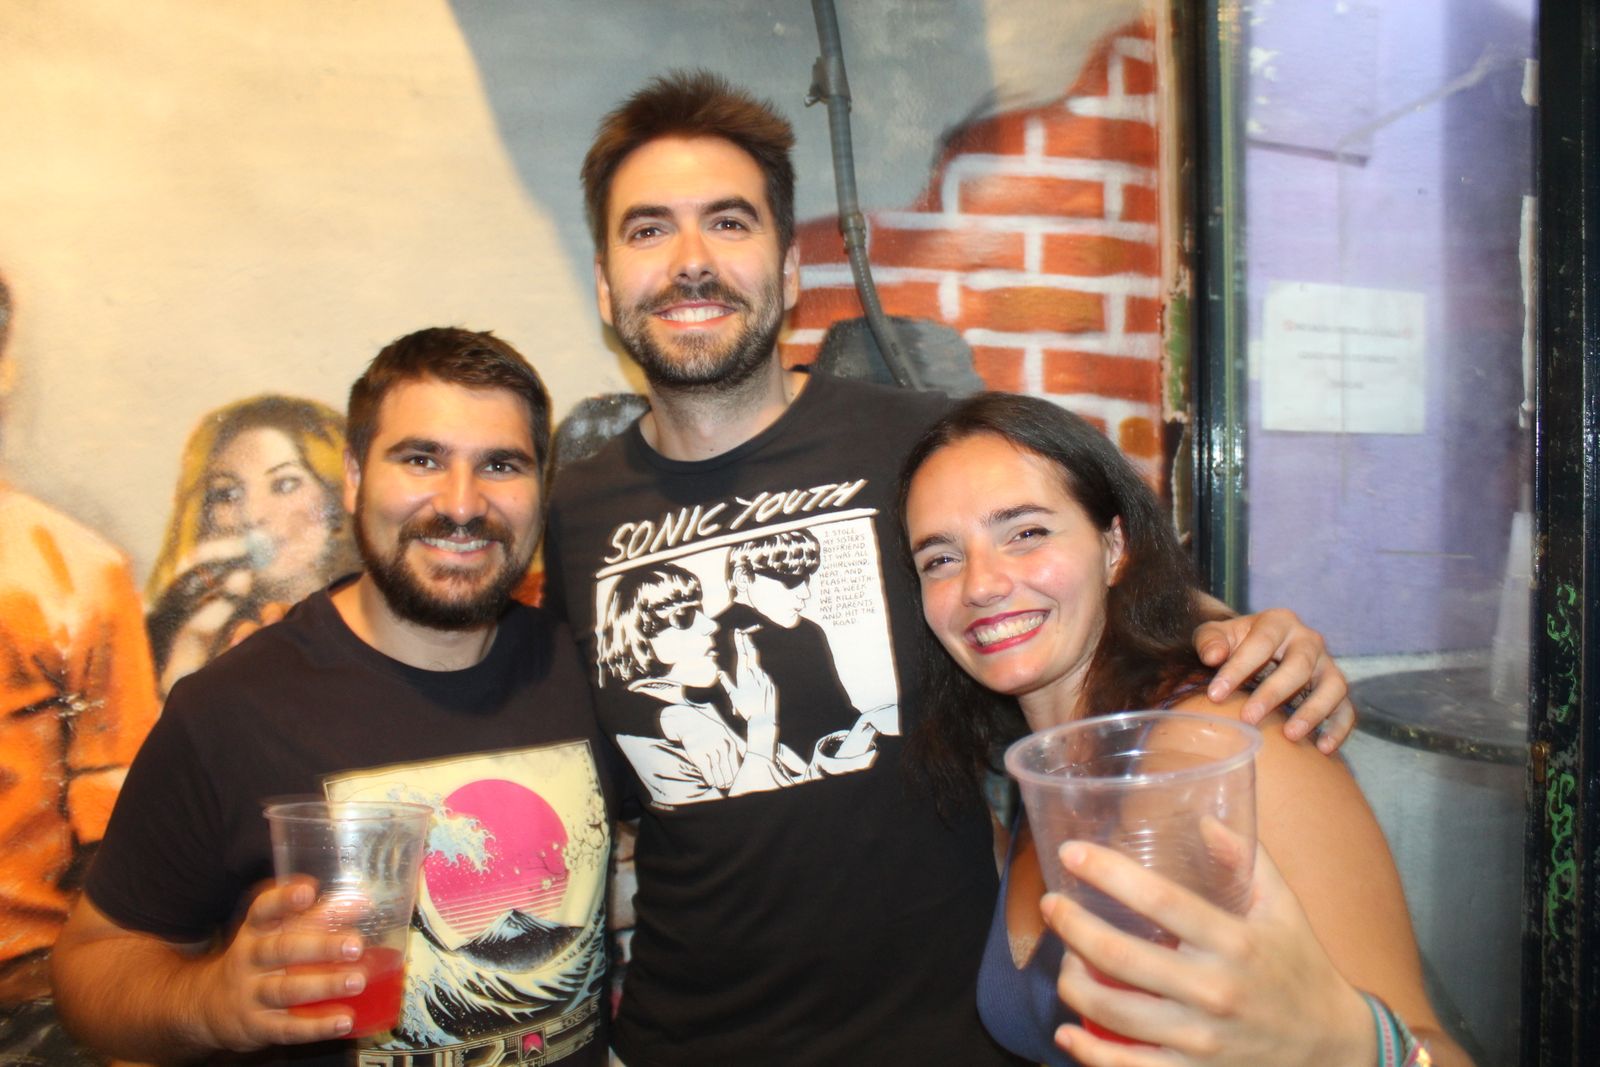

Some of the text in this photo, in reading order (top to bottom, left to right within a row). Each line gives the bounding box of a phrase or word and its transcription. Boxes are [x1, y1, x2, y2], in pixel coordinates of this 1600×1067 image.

[604, 478, 868, 564] SONIC YOUTH
[831, 528, 856, 537] STOLE
[822, 538, 834, 546] MY
[822, 542, 866, 555] BOYFRIEND
[822, 549, 868, 563] IT WAS ALL
[844, 567, 863, 576] AND
[820, 587, 830, 597] IN
[843, 583, 867, 592] WEEK
[819, 591, 865, 605] WE KILLED
[819, 598, 873, 613] MY PARENTS
[822, 606, 876, 621] AND HIT THE
